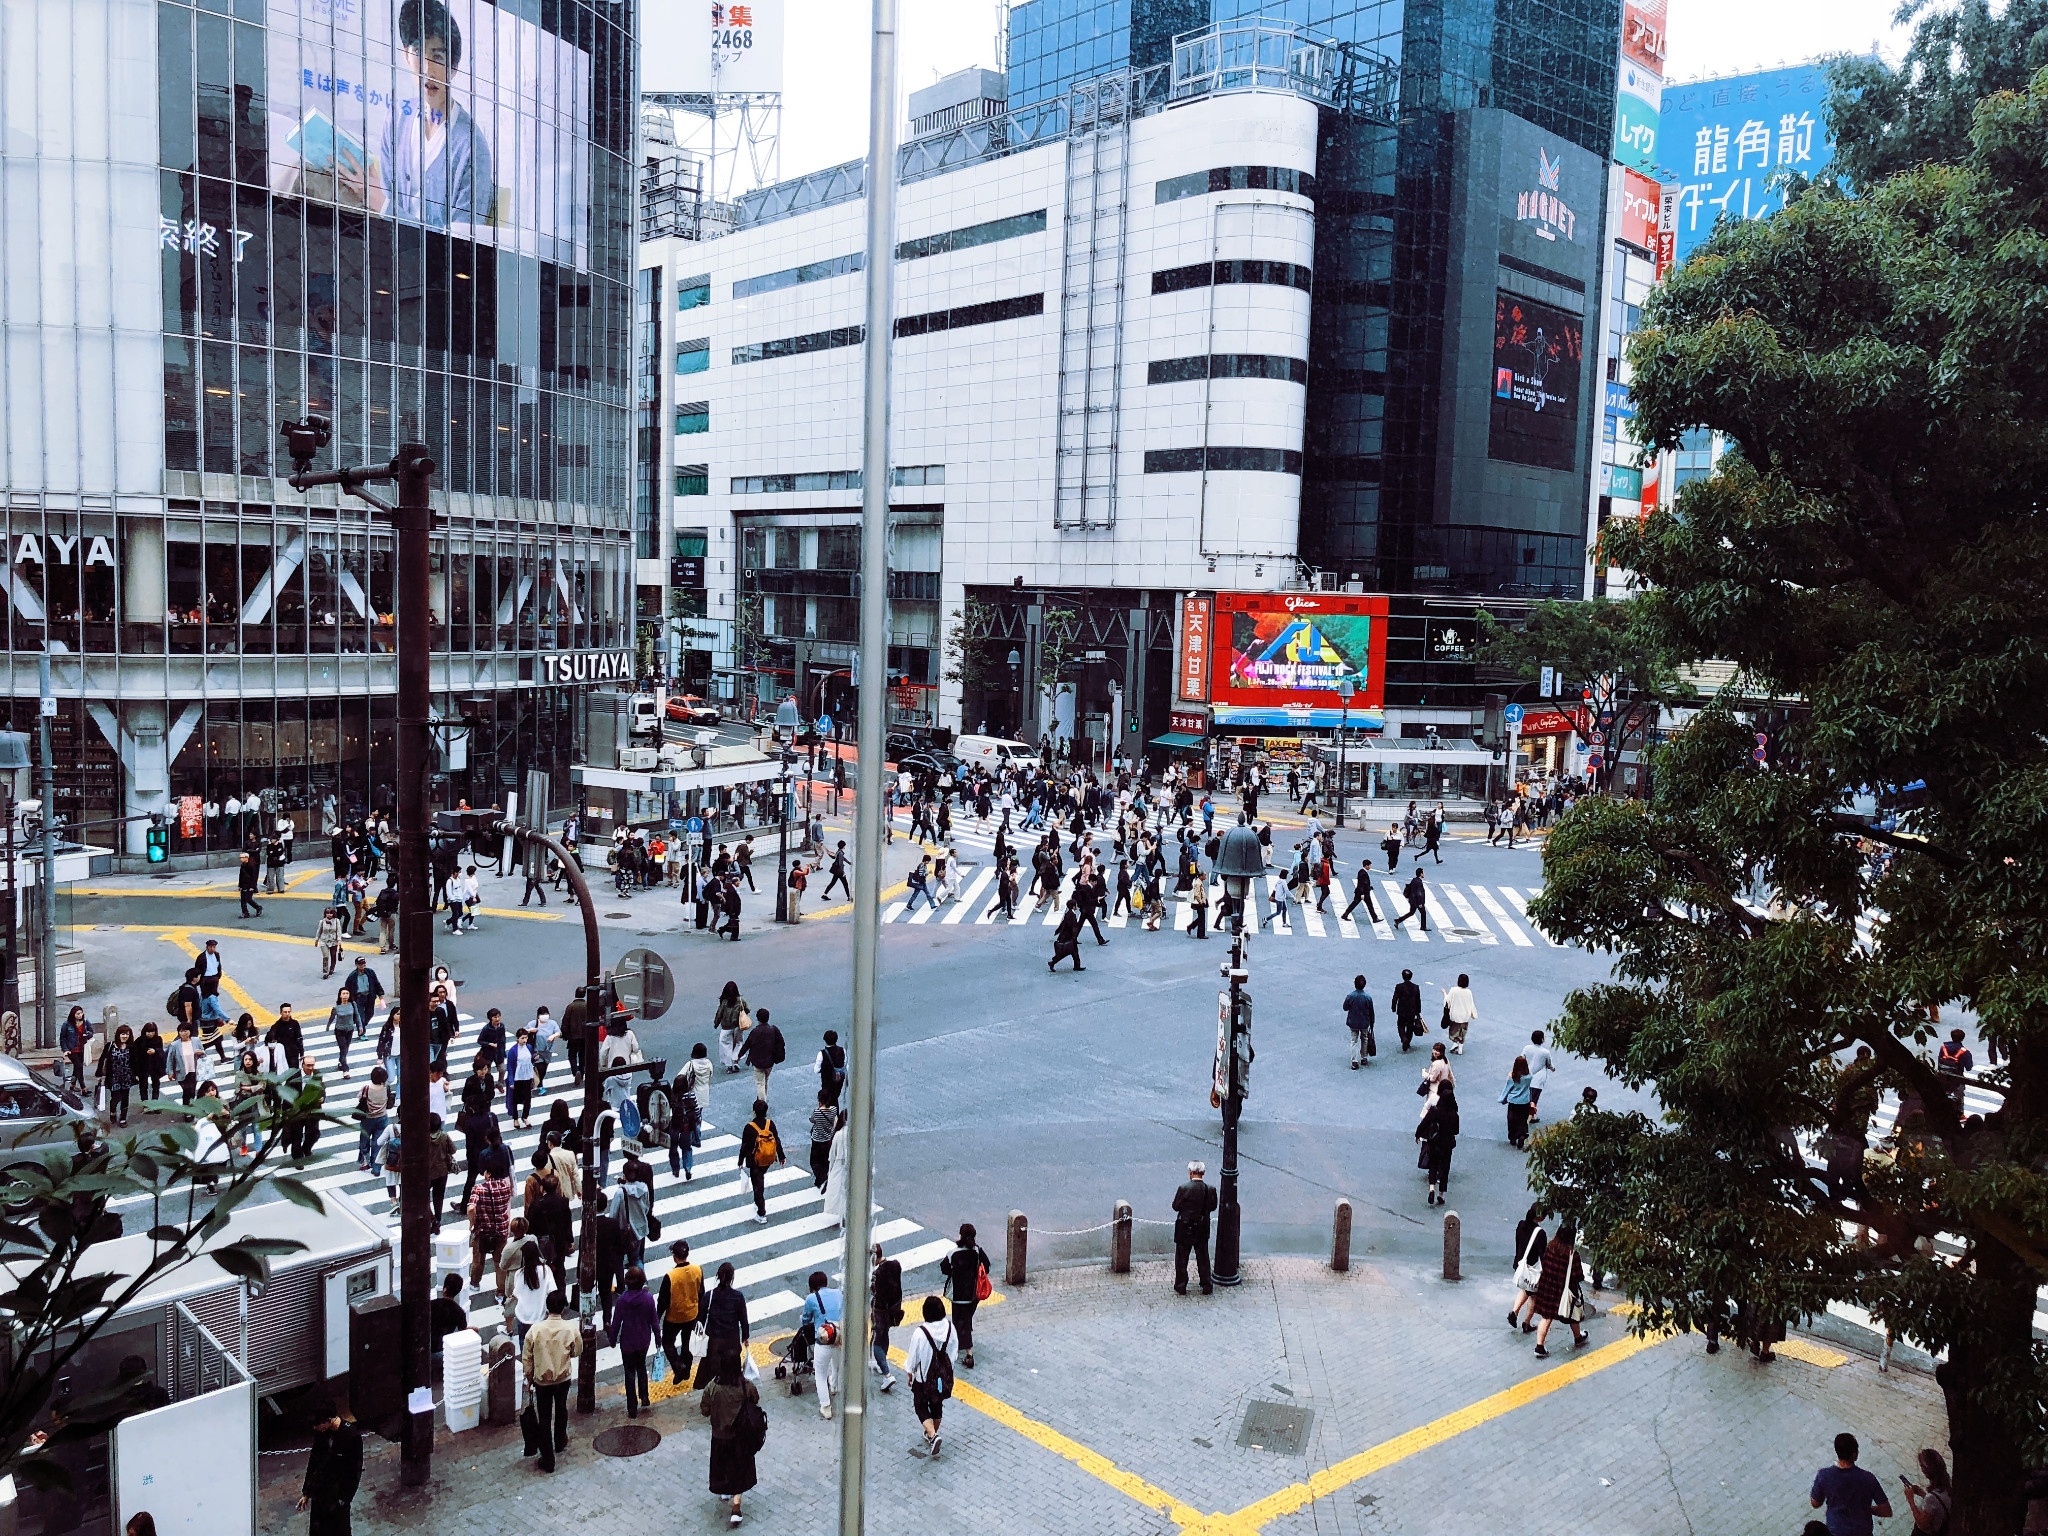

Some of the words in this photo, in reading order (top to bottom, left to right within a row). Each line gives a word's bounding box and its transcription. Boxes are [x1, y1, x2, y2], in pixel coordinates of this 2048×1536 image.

[712, 30, 752, 49] 2468
[1632, 15, 1667, 61] アコム
[303, 68, 443, 125] 僕は声をかるけ
[1620, 114, 1655, 154] レイク
[1694, 110, 1816, 176] 龍角散
[1517, 190, 1576, 241] MAGNET
[1624, 190, 1658, 225] アイフル
[1647, 235, 1657, 250] 8F
[1612, 474, 1629, 489] レイク
[0, 532, 116, 567] AYA
[1186, 601, 1207, 612] 名物
[1285, 597, 1320, 611] Glico
[545, 653, 630, 681] TSUTAYA
[1186, 614, 1203, 697] 天津甘栗
[1171, 716, 1203, 730] 天津甘栗
